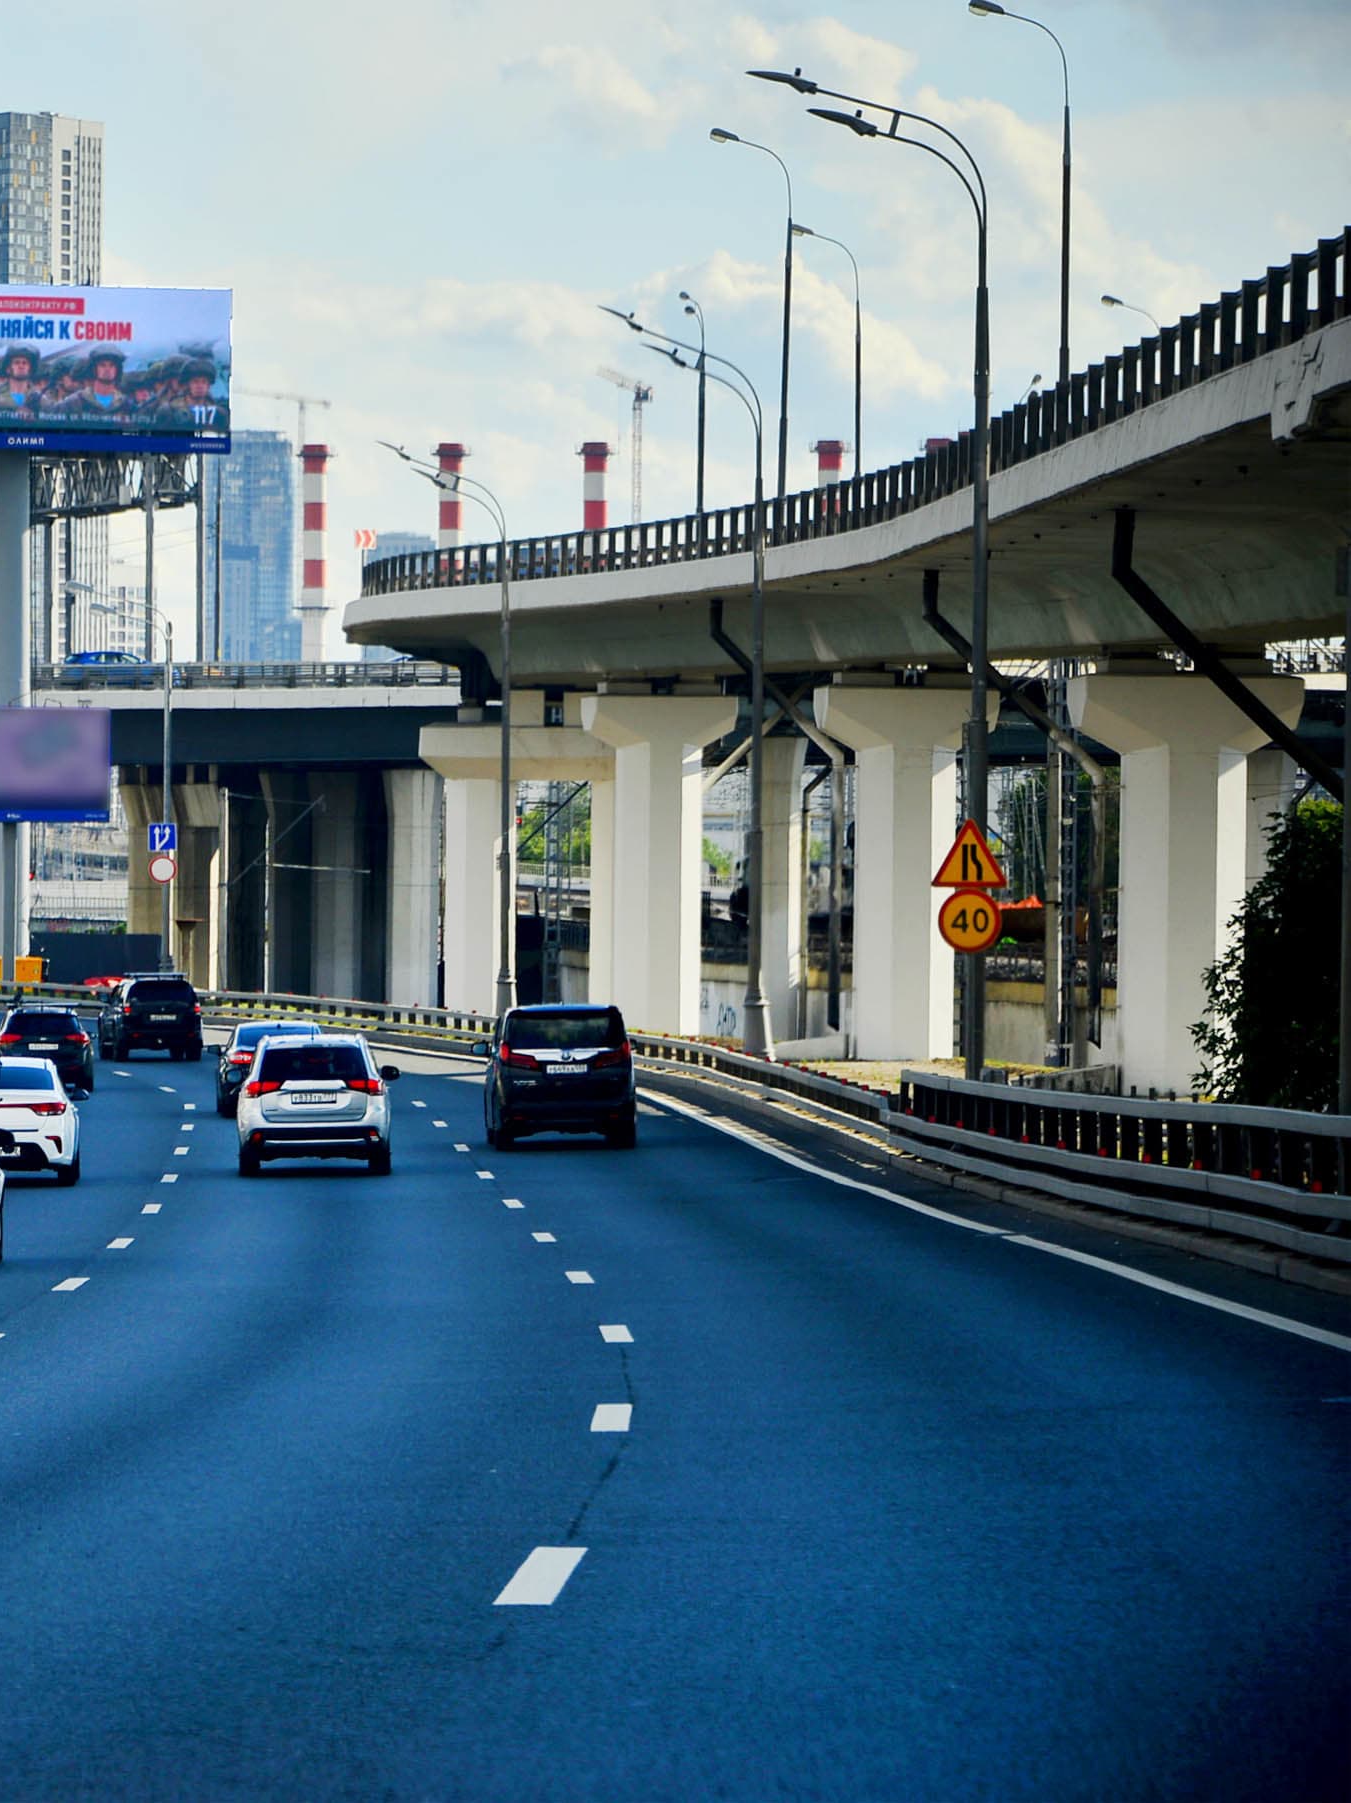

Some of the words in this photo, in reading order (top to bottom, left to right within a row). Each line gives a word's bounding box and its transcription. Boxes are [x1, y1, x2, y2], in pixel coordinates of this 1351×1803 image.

[59, 320, 70, 340] К
[74, 321, 132, 341] СВОИМ
[192, 405, 216, 425] 117
[7, 437, 45, 445] ОЛИМП
[951, 908, 989, 933] 40
